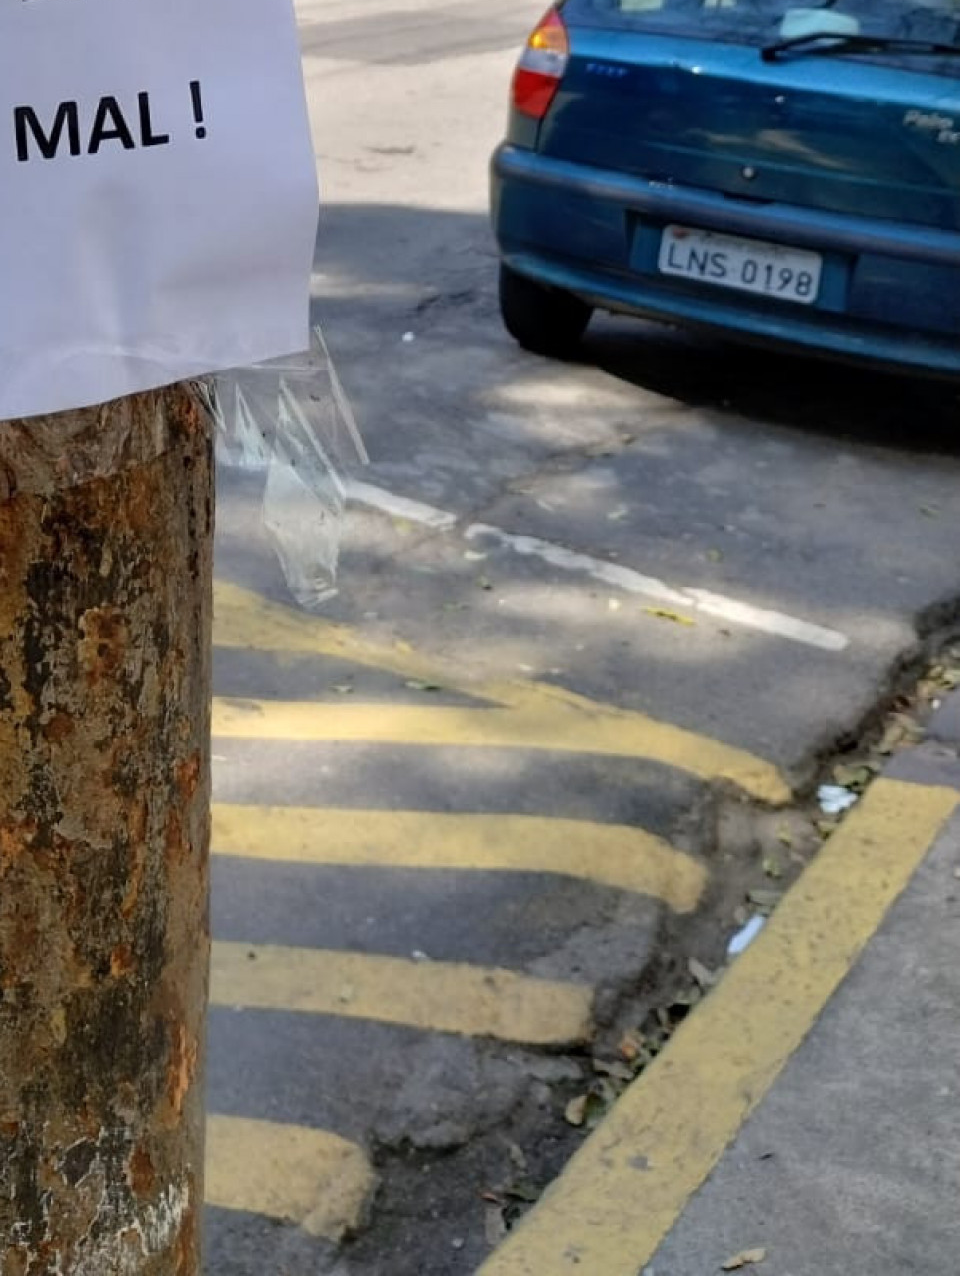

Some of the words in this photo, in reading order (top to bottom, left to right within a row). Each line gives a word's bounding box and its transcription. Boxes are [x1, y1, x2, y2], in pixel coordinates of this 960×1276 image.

[13, 91, 170, 162] MAL
[667, 242, 728, 278] LNS
[741, 259, 813, 297] 0198
